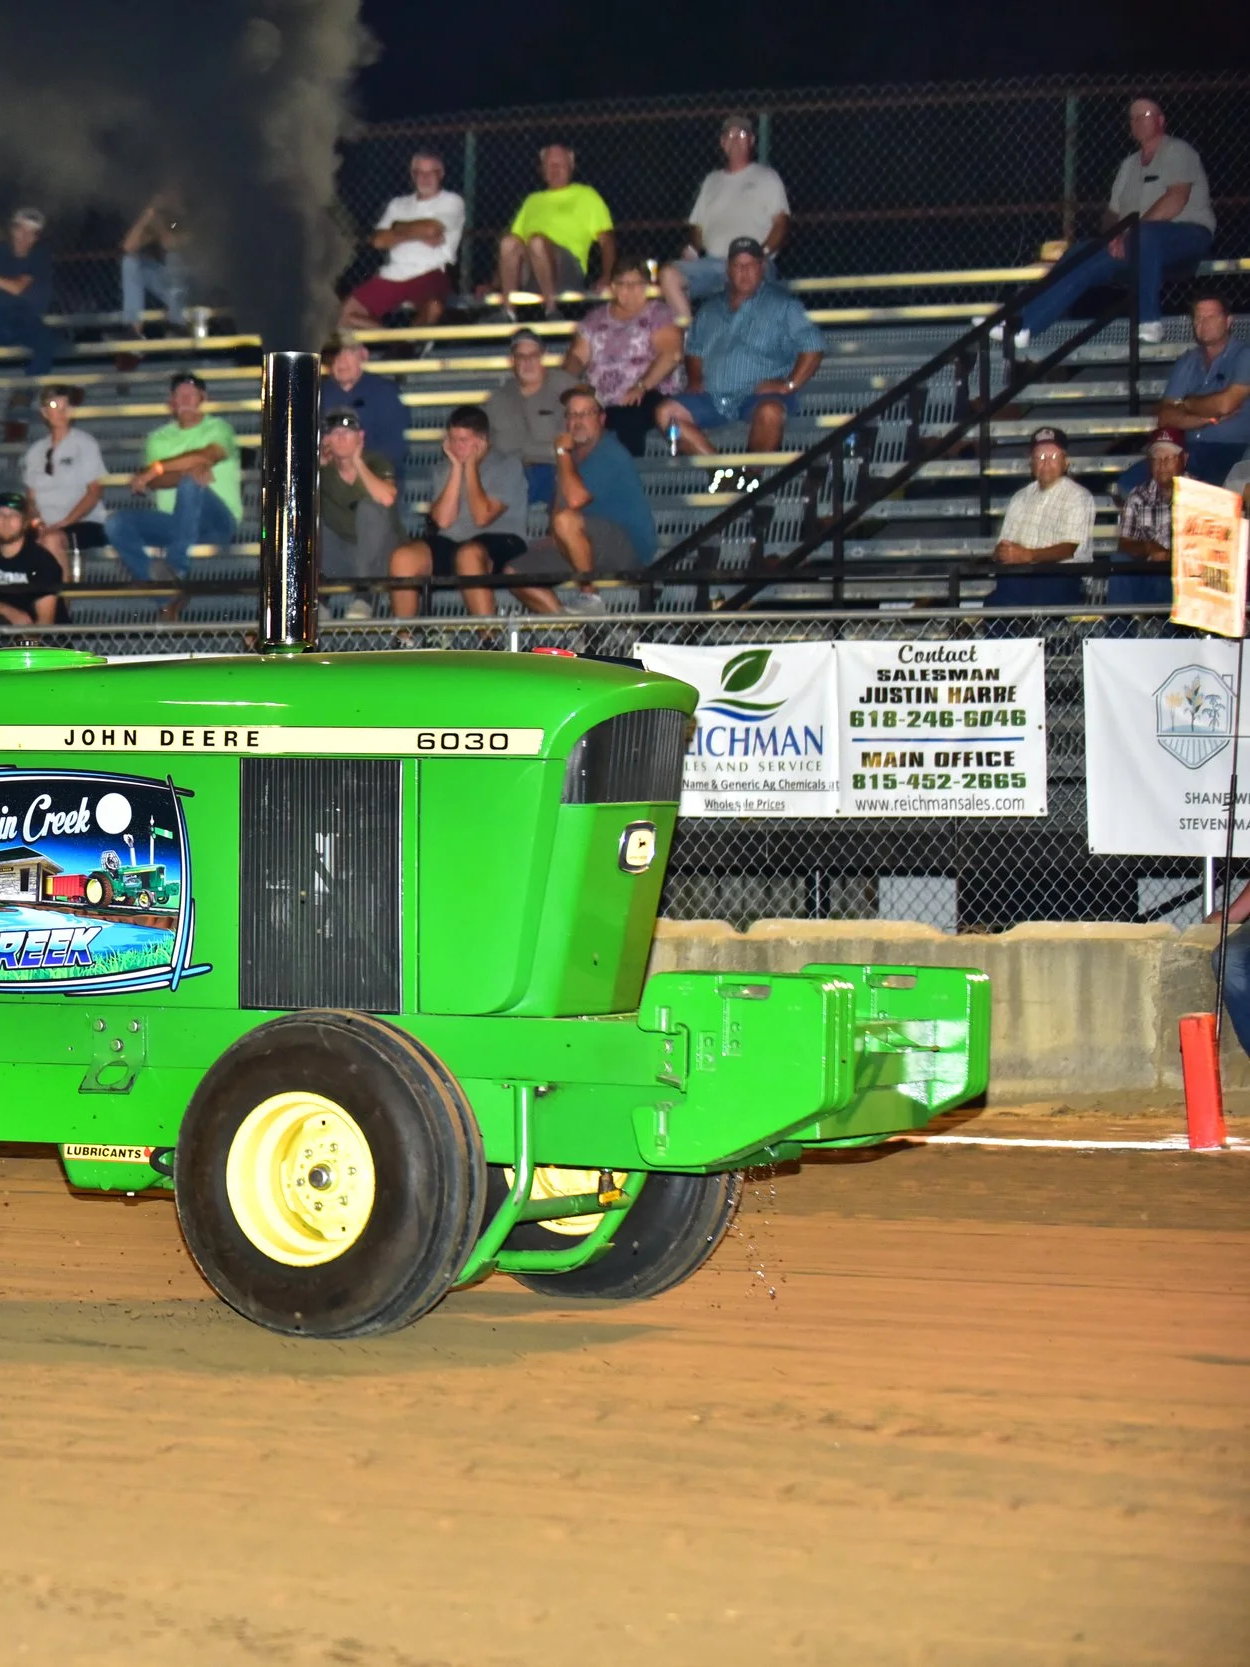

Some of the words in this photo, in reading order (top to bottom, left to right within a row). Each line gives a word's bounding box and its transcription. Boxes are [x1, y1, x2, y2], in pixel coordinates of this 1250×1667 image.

[898, 644, 978, 664] Contact
[876, 668, 1000, 682] SALESMAN
[859, 686, 939, 704] JUSTIN
[947, 685, 1017, 704] HARRE
[849, 709, 1027, 728] 618-246-6046
[64, 729, 137, 746] JOHN
[160, 730, 259, 747] DEERE
[417, 732, 509, 750] 6030
[685, 725, 824, 757] ICHMAN
[684, 761, 707, 772] LES
[715, 761, 749, 772] AND
[758, 760, 823, 772] SERVICE
[861, 751, 925, 768] MAIN
[934, 750, 1015, 768] OFFICE
[682, 779, 709, 790] Name
[711, 779, 718, 790] &
[720, 779, 761, 790] Generic
[762, 779, 776, 791] Ag
[778, 778, 826, 790] Chemicals
[851, 772, 1027, 790] 815-452-2665
[704, 799, 754, 810] Wholesle
[756, 799, 785, 810] Prices
[855, 794, 1025, 812] www.reichmansales.com
[1184, 792, 1231, 804] SHANE
[22, 793, 91, 843] Creek
[1179, 818, 1228, 830] STEVEN
[66, 1146, 141, 1158] LUBRICANTS
